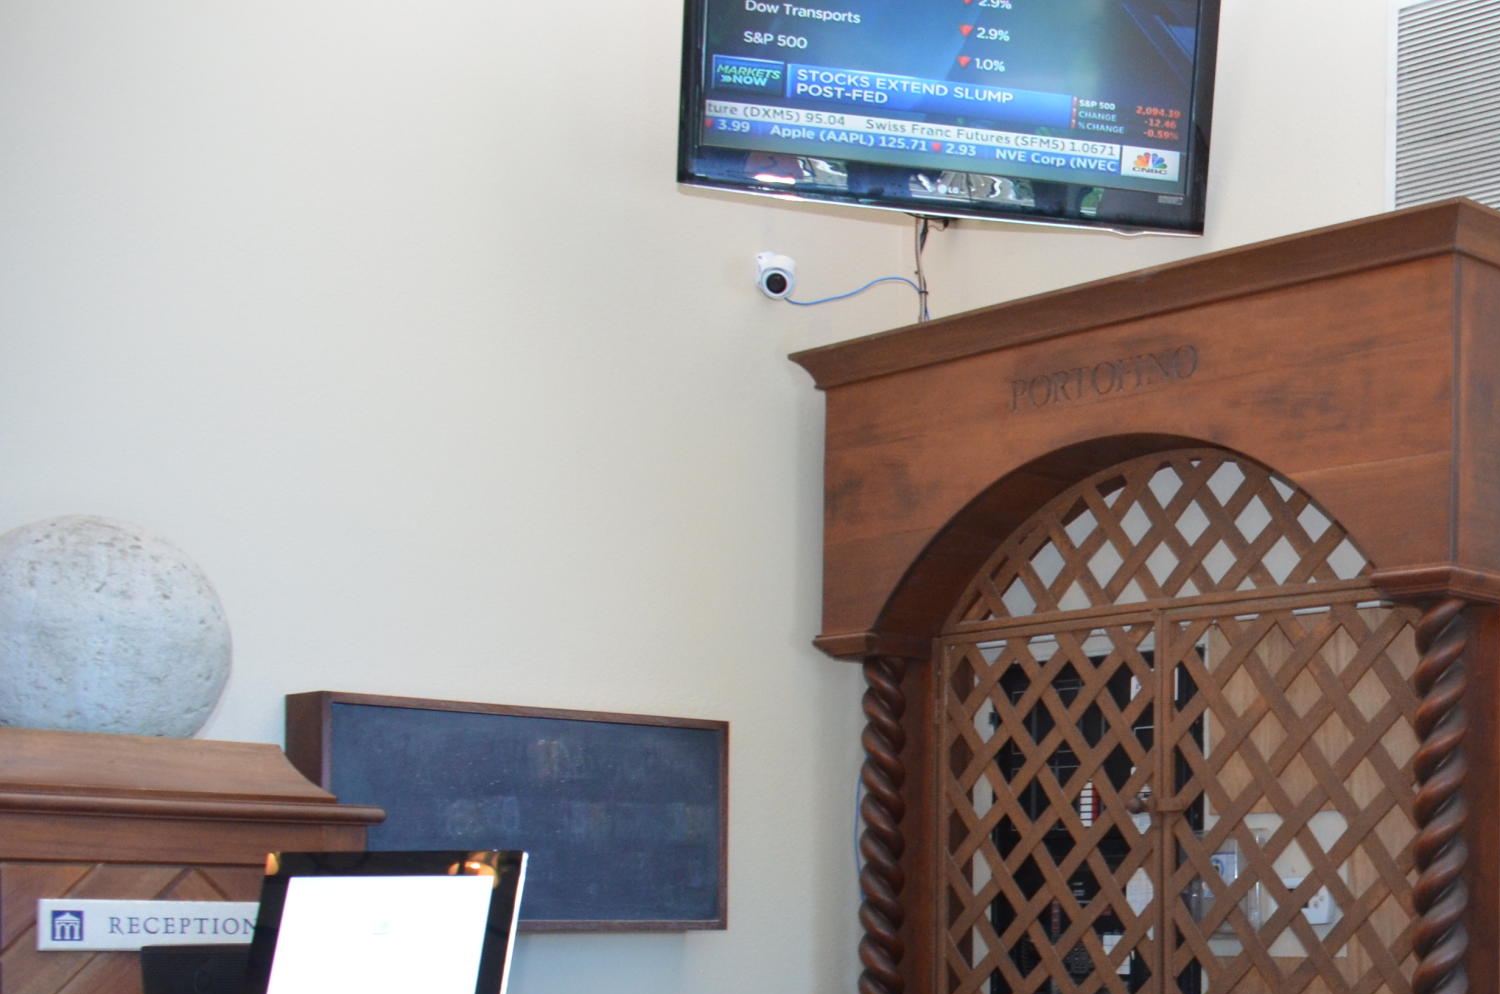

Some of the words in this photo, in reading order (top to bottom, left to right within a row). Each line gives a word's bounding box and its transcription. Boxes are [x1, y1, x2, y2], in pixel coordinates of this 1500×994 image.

[744, 0, 780, 13] Dow
[784, 4, 862, 24] Transports
[744, 31, 774, 45] S&P
[777, 36, 808, 49] 500
[976, 27, 1010, 42] 2.9%
[717, 64, 782, 80] MARKETS
[975, 58, 1006, 72] 1.0%
[732, 75, 769, 87] NOW
[797, 69, 870, 88] STOCKS
[876, 78, 949, 96] EXTEND
[954, 86, 1014, 103] SLUMP
[797, 83, 888, 104] POST-FED
[1079, 110, 1117, 122] CHANGE
[806, 113, 846, 126] 95.04
[866, 119, 906, 133] Swiss
[911, 125, 950, 138] Franc
[957, 129, 1010, 144] Futures
[1070, 142, 1116, 157] 1.0671
[1086, 123, 1125, 134] CHANGE
[718, 119, 750, 133] 3.99
[770, 125, 815, 139] Apple
[819, 130, 874, 147] (AAPL)
[880, 136, 927, 151] 125.71
[945, 143, 976, 157] 2.93
[996, 149, 1027, 162] NVE
[1031, 152, 1066, 168] Corp
[1008, 344, 1199, 414] PORTOFINO
